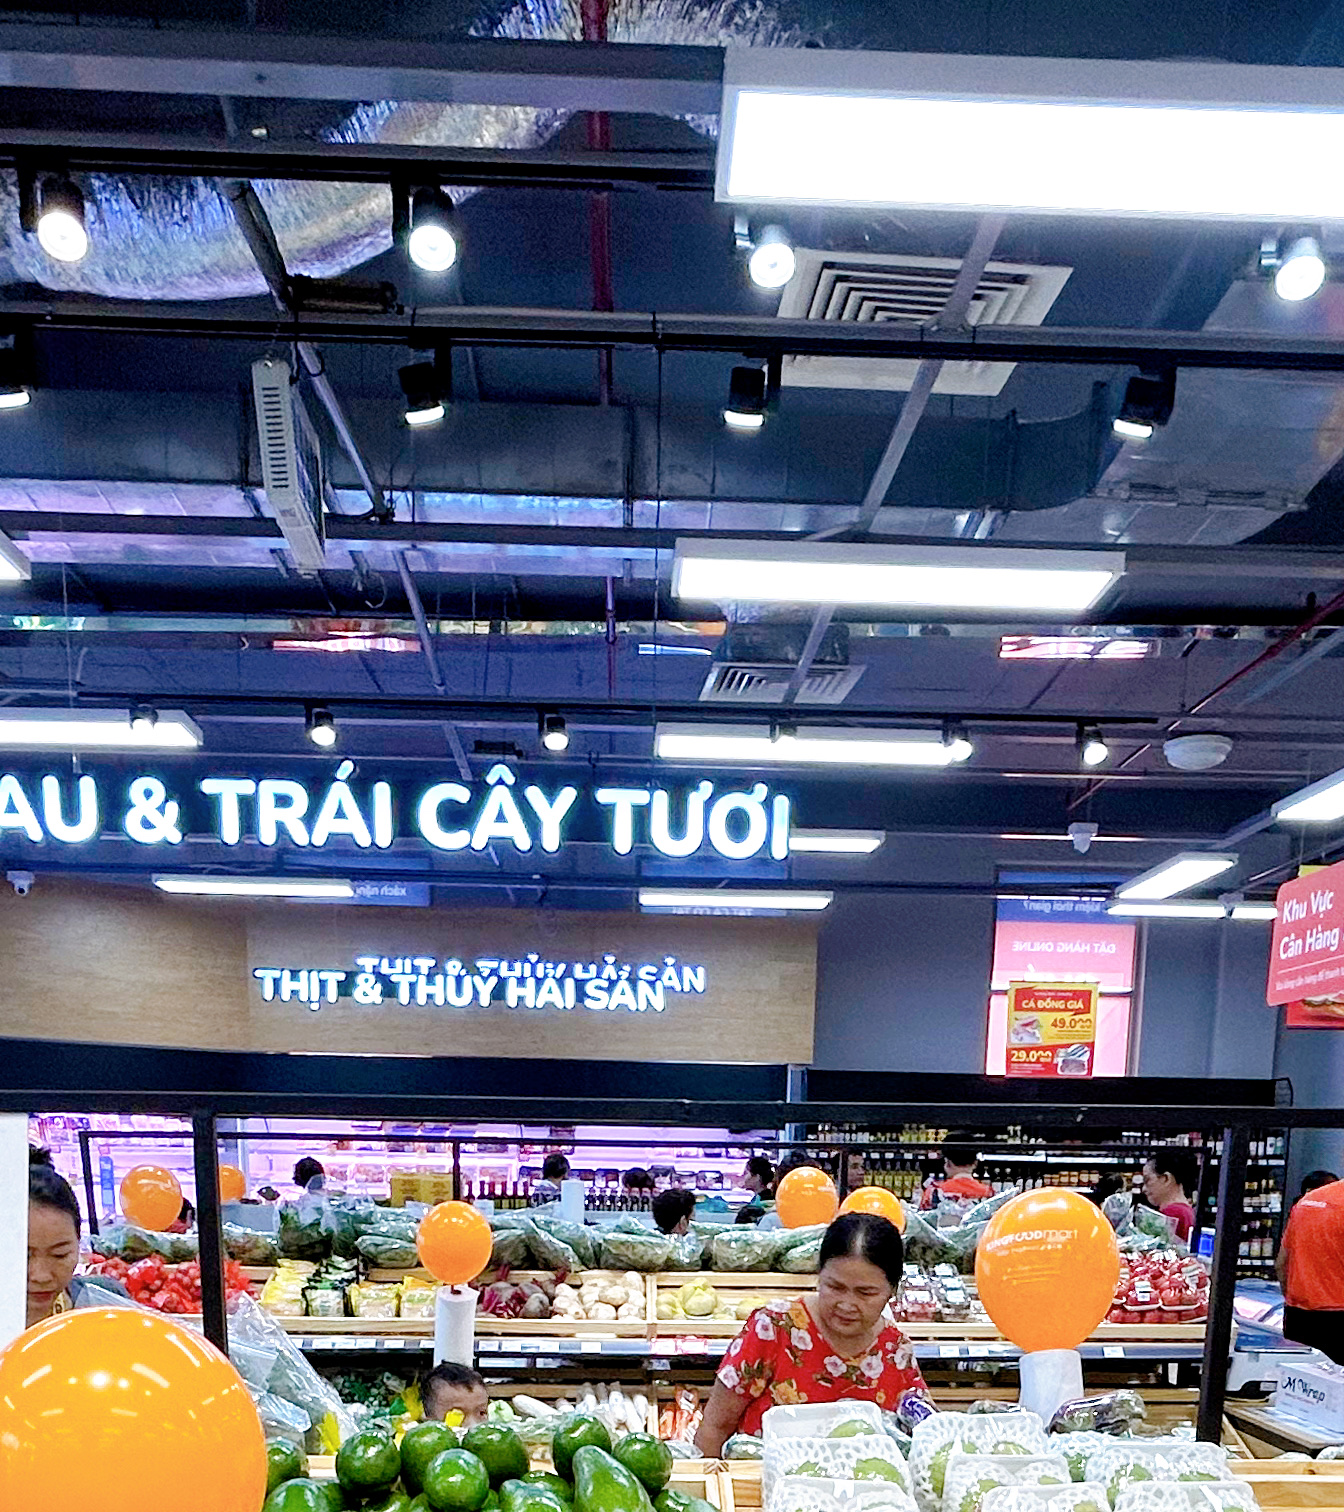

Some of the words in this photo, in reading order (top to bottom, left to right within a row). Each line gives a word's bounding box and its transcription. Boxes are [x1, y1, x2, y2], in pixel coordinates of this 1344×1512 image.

[123, 775, 184, 846] &
[200, 758, 395, 851] TRÁI
[417, 764, 577, 853] CÂY
[596, 777, 791, 861] TƯƠI
[1282, 898, 1307, 924] Khu
[1310, 889, 1335, 918] Vực
[1279, 933, 1303, 960] Cân
[1305, 925, 1340, 953] Hàng
[254, 969, 348, 1011] THỊT
[354, 973, 384, 1005] &
